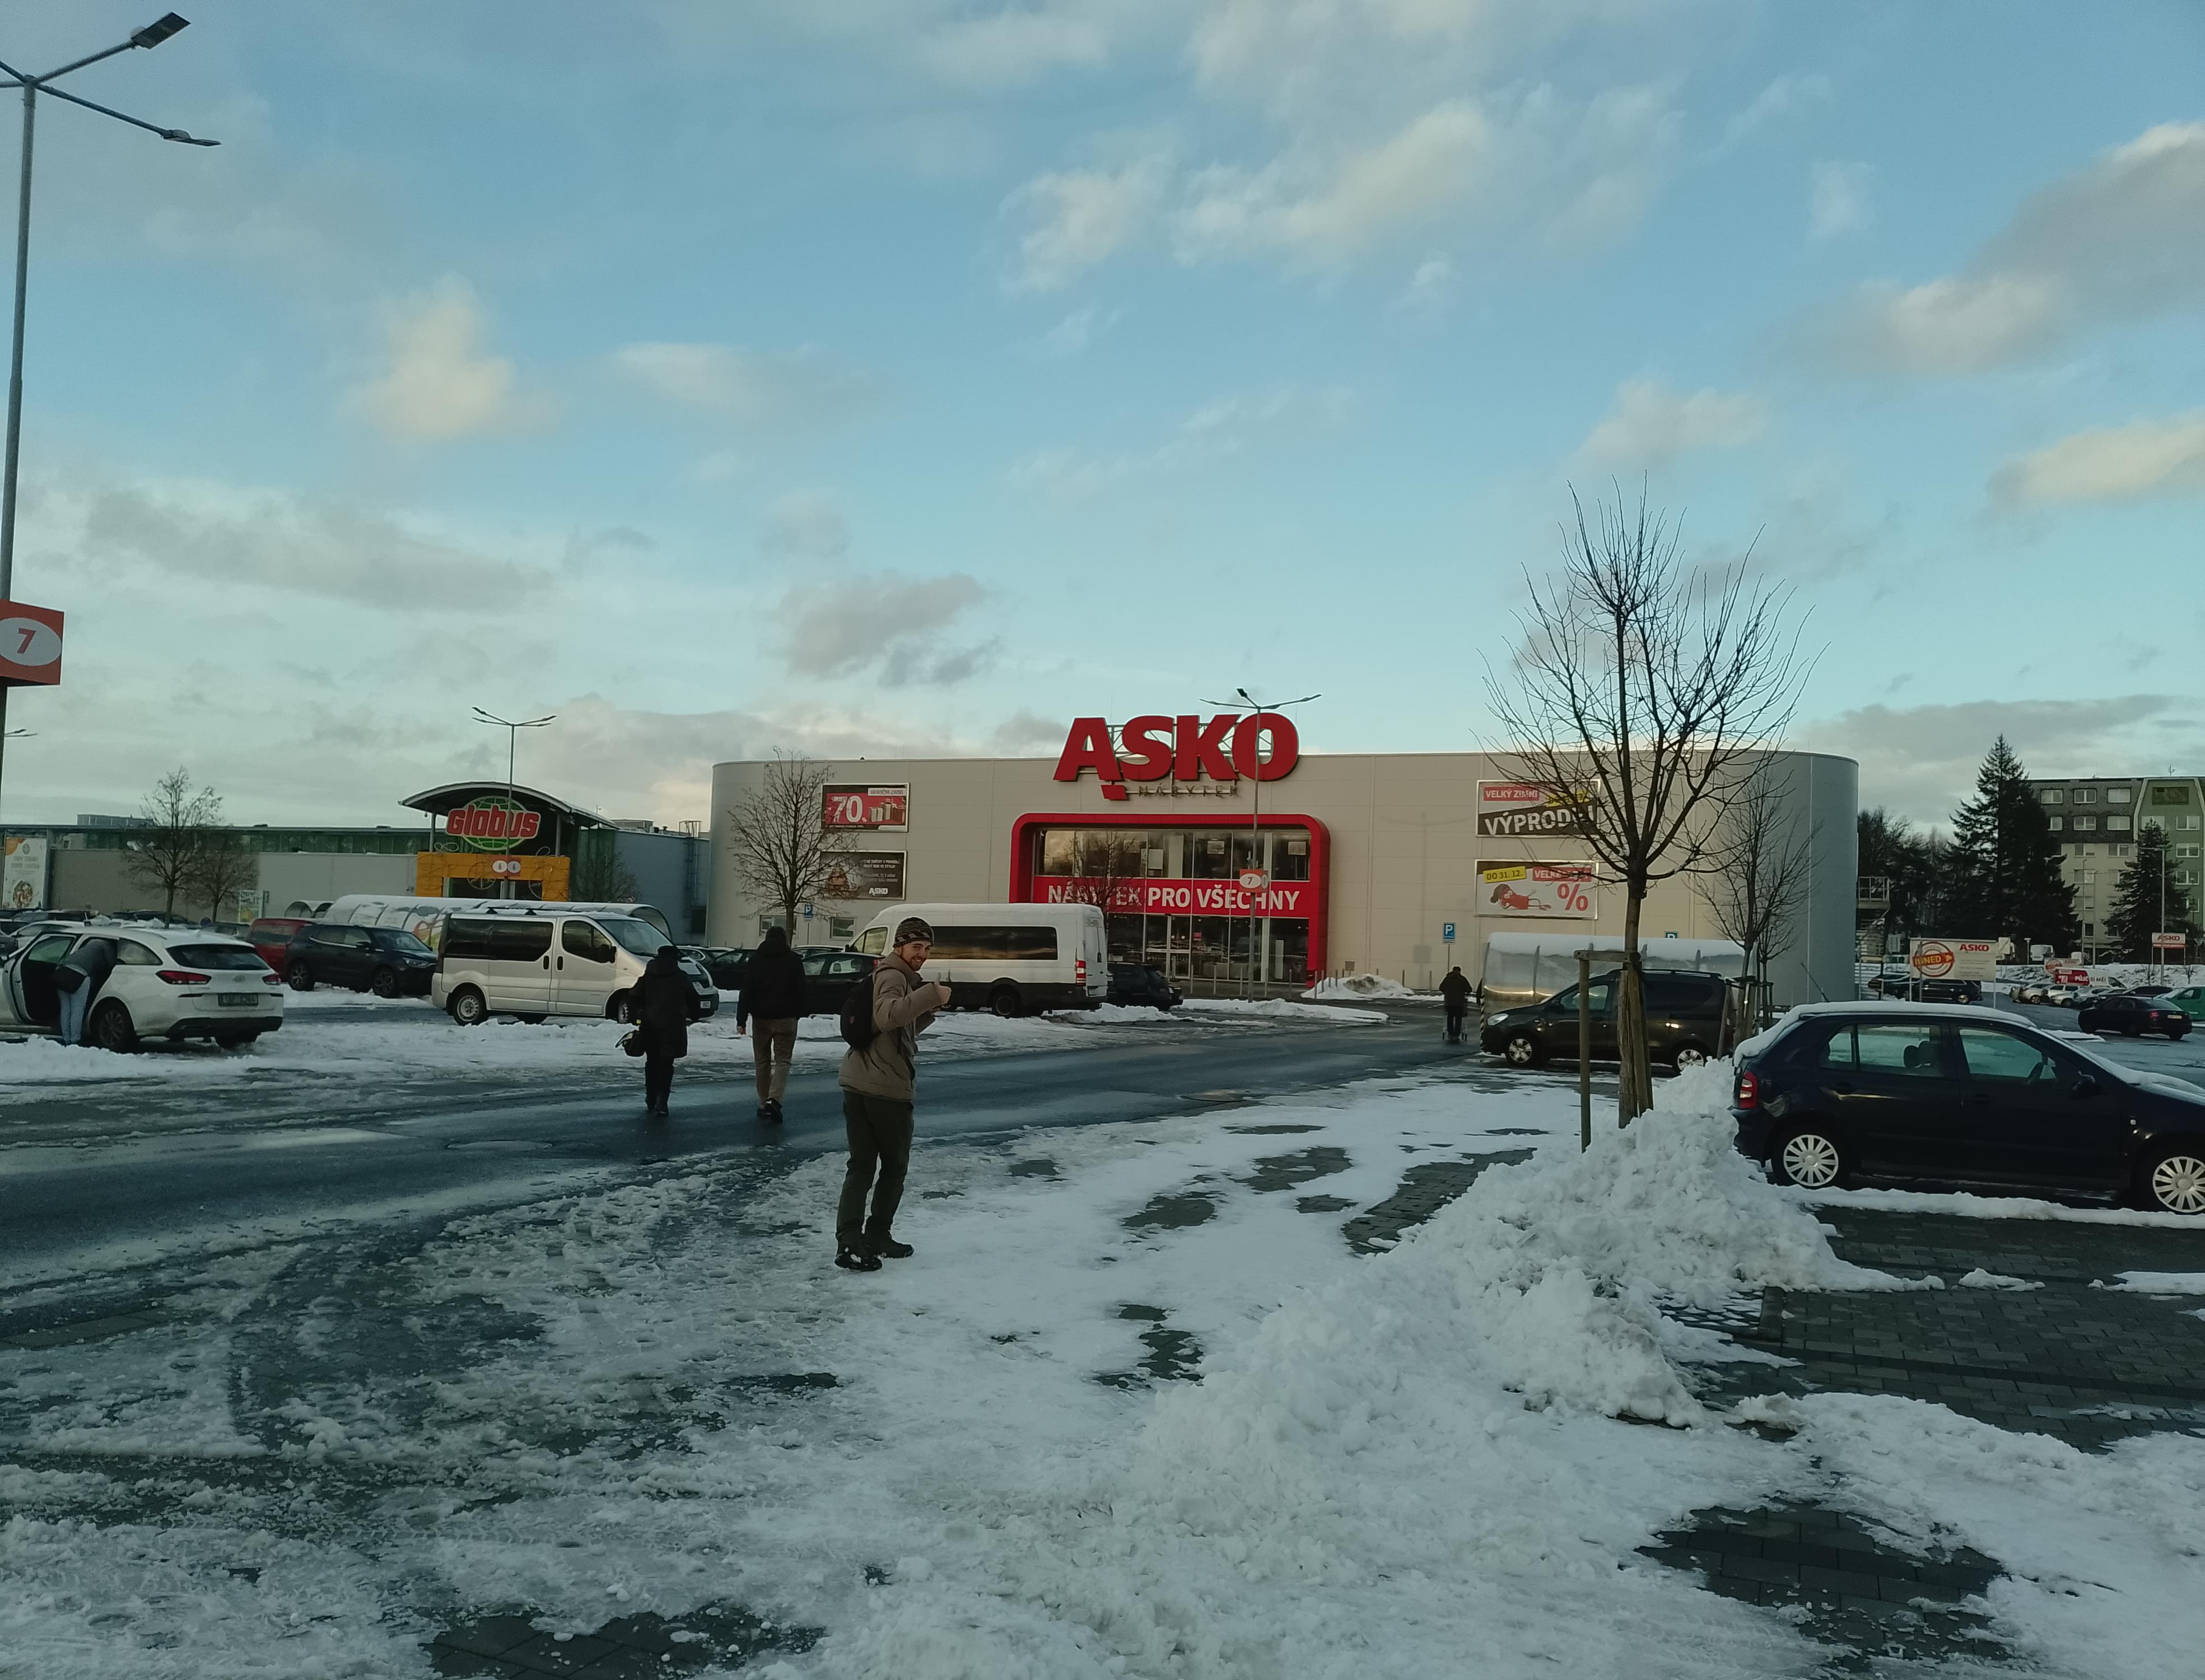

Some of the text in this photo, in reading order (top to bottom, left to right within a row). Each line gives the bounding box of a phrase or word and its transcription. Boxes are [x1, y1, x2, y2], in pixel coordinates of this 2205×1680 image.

[17, 627, 36, 655] 7
[1053, 712, 1299, 782] ASKO
[1138, 782, 1238, 797] NÁBYTEK
[1485, 788, 1512, 798] VELKÝ
[1248, 876, 1253, 885] 7
[1148, 888, 1191, 907] PRO
[1196, 884, 1300, 911] VŠECHNY
[805, 906, 812, 914] P
[1446, 924, 1453, 935] P
[1959, 944, 1990, 953] ASKO
